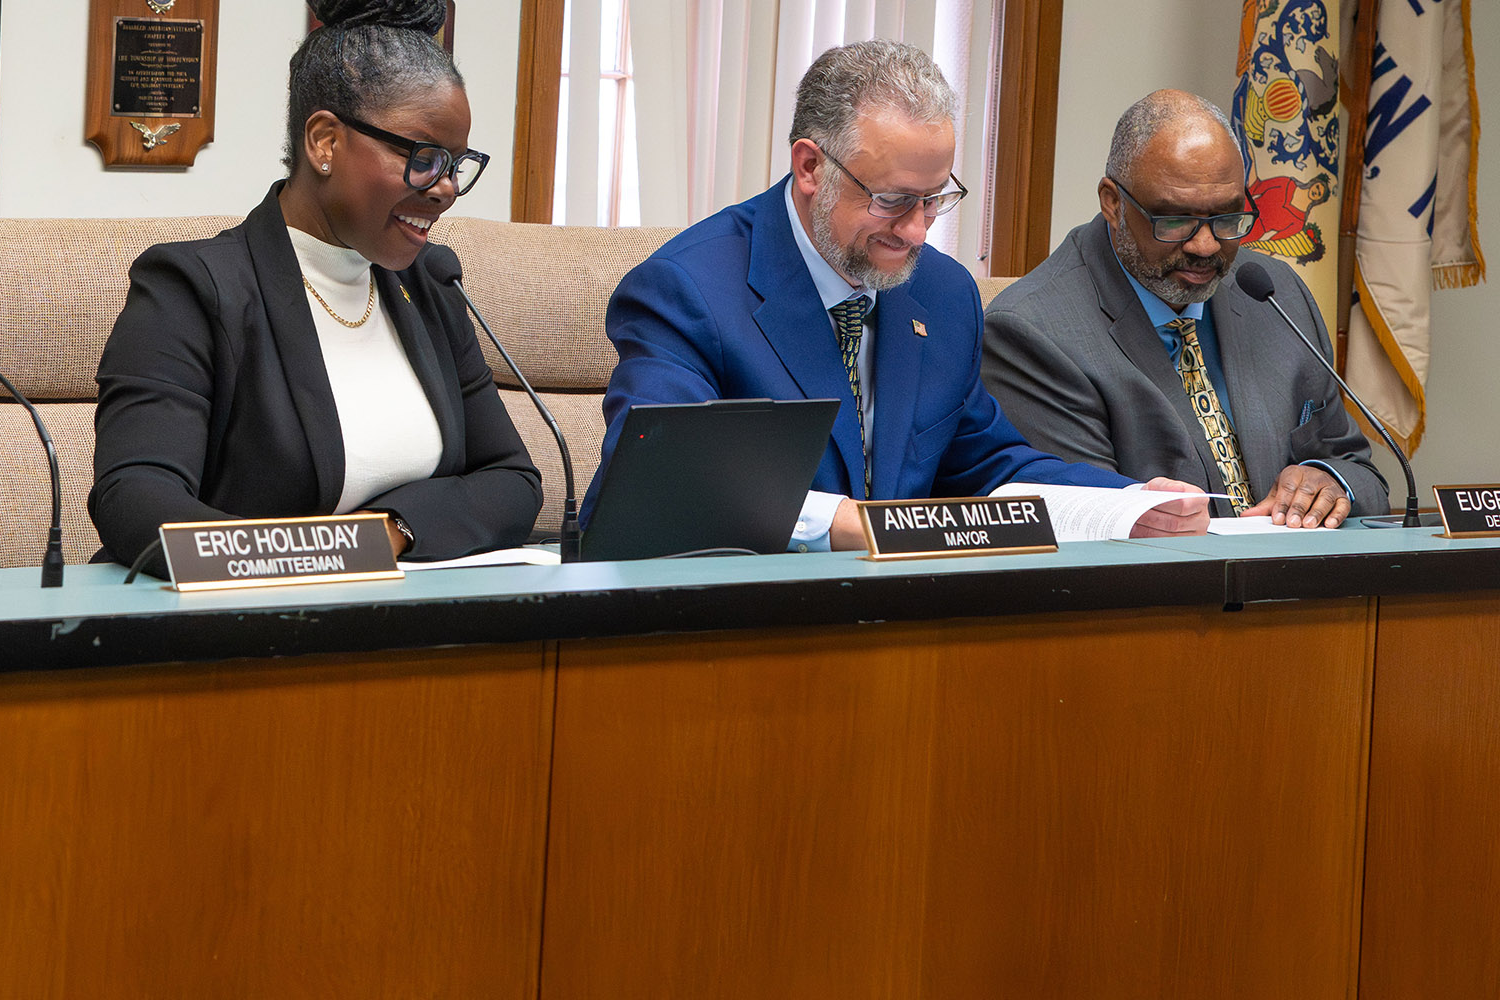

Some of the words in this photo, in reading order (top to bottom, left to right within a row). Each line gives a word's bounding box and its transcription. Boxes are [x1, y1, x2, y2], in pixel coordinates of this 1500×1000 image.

[884, 505, 958, 531] ANEKA
[961, 502, 1040, 527] MILLER
[194, 530, 251, 557] ERIC
[254, 524, 359, 554] HOLLIDAY
[944, 531, 990, 546] MAYOR
[227, 554, 345, 577] COMMITTEEMAN
